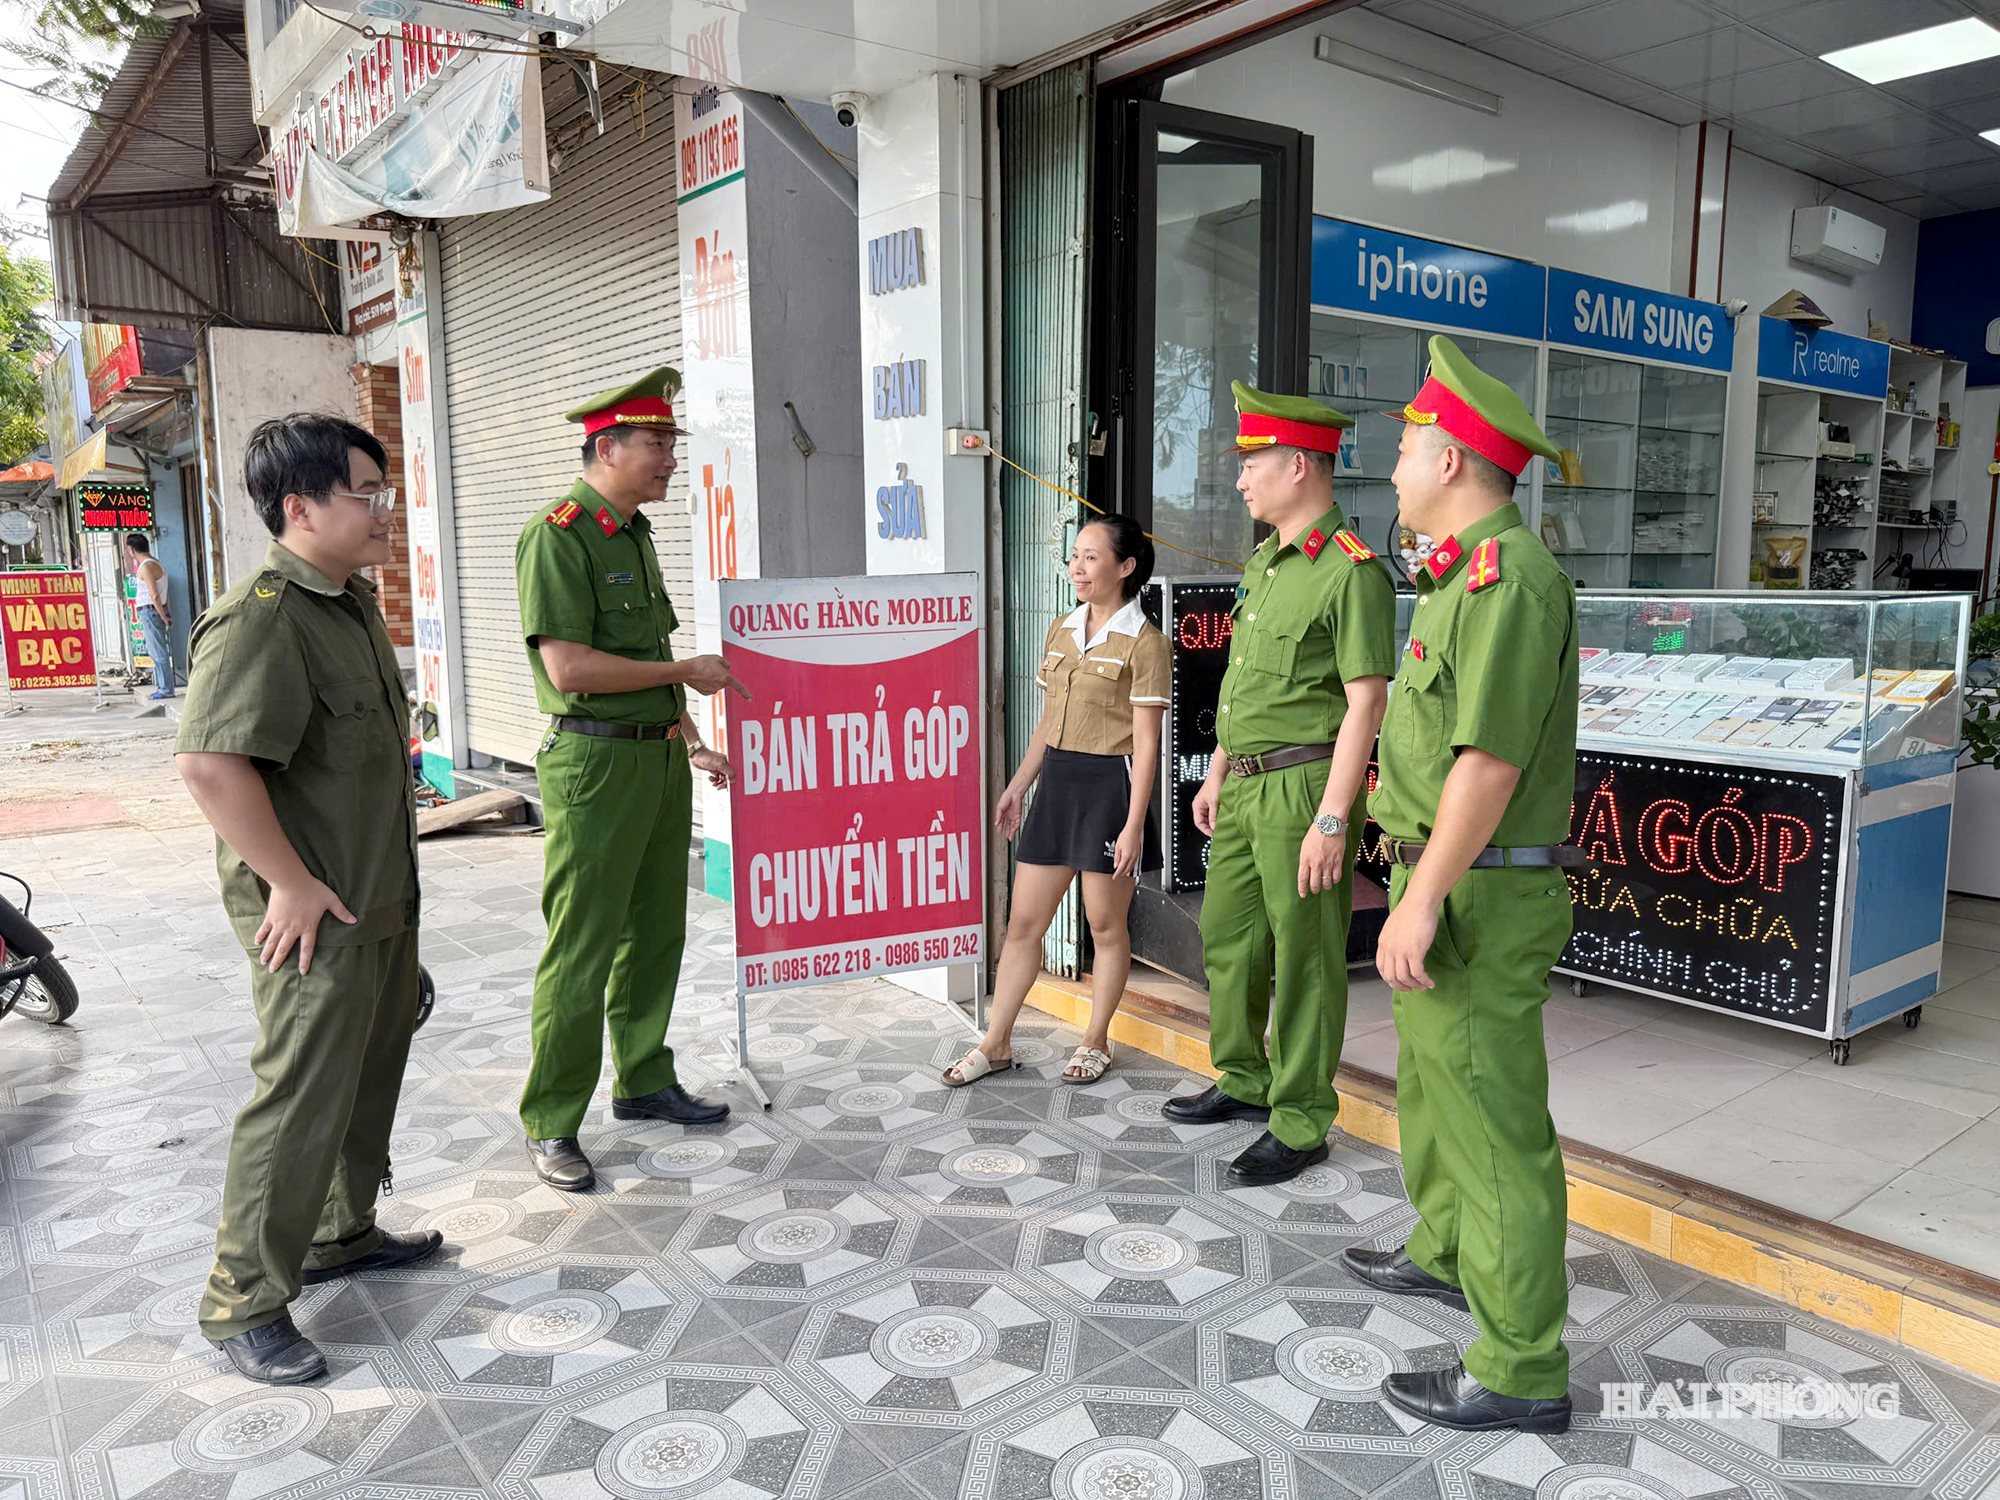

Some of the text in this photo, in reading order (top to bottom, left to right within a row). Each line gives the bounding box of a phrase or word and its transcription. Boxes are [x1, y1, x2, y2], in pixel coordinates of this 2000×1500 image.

[681, 113, 738, 191] 098 1193 666
[868, 227, 925, 295] MUA
[1358, 239, 1488, 308] iphone
[1574, 289, 1714, 354] SAM SUNG
[405, 345, 425, 405] Sim
[873, 352, 926, 421] BÁN
[1813, 348, 1860, 378] realme
[107, 492, 147, 507] VÀNG
[702, 446, 737, 581] Trả
[877, 462, 927, 540] SỬA
[1, 575, 85, 595] MINH THÂN
[6, 599, 87, 632] VÀNG
[729, 586, 973, 637] QUANG HẰNG MOBILE
[18, 636, 83, 671] BẠC
[740, 701, 818, 796] BÁN
[827, 684, 893, 788] TRẢ
[903, 690, 970, 780] GÓP
[750, 810, 970, 928] CHUYỂN TIỀN
[1637, 787, 1813, 893] GÓP
[1656, 895, 1798, 950] CHỮA
[745, 962, 768, 988] ĐT:
[773, 957, 809, 984] 0985
[813, 951, 841, 978] 622
[845, 945, 871, 973] 218
[886, 941, 919, 967] 0986
[924, 936, 949, 962] 550
[953, 932, 978, 958] 242
[1572, 930, 1797, 1004] CHÍNH CHỦ
